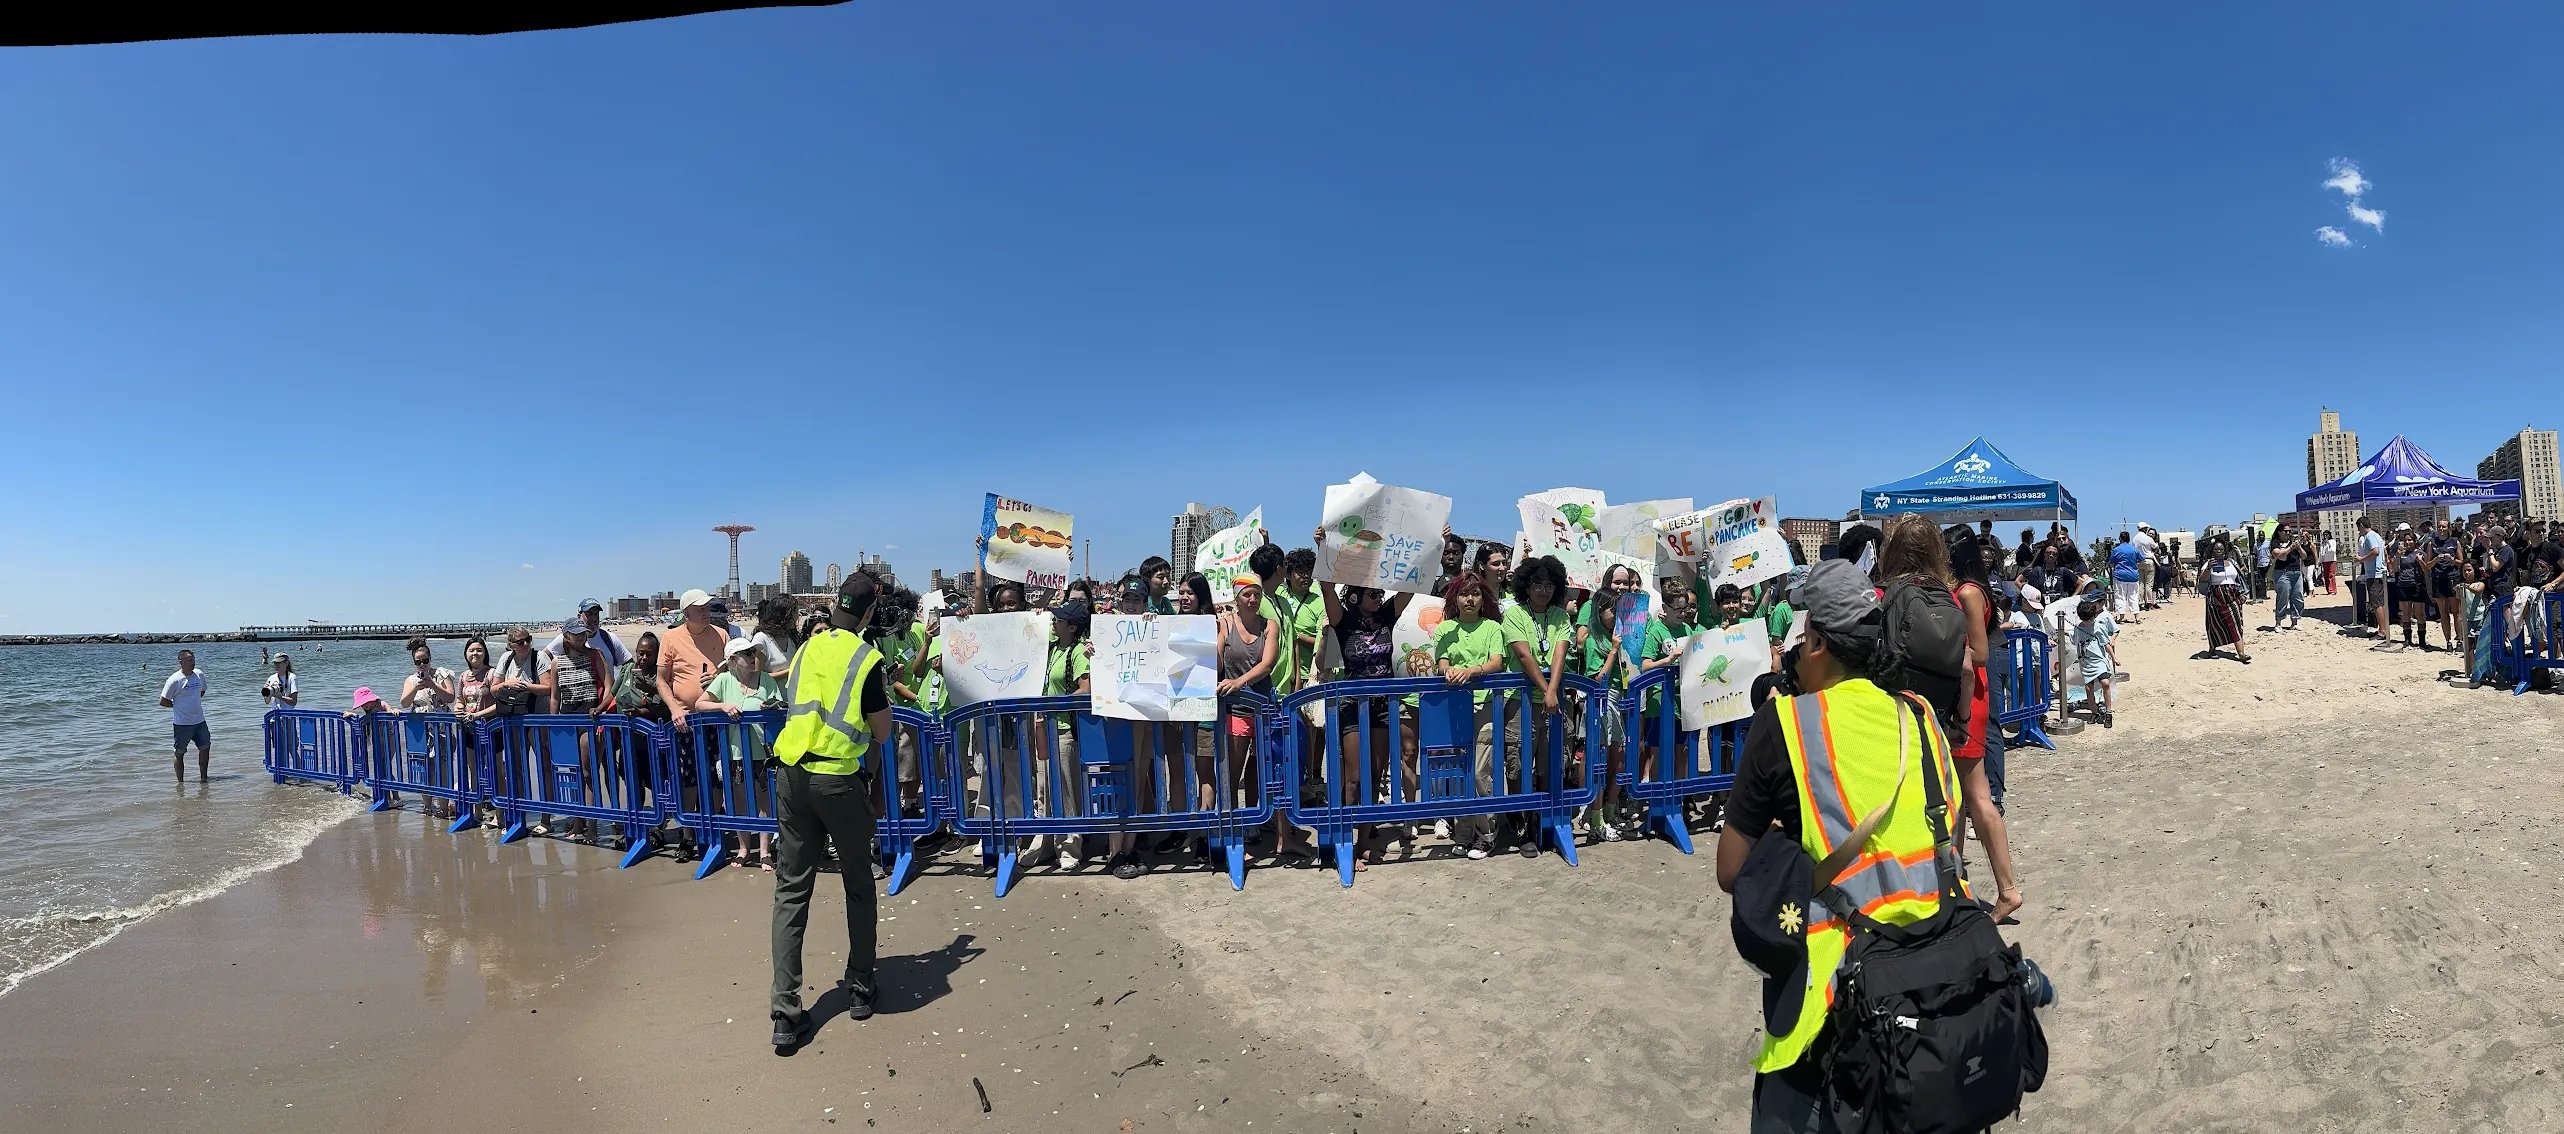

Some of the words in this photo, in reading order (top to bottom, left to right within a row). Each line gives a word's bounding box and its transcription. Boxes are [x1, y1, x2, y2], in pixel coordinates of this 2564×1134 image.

[1932, 495, 1969, 503] Stranding
[2405, 487, 2428, 497] New
[2428, 486, 2449, 496] York
[2451, 486, 2495, 498] Aquarium
[1715, 518, 1758, 546] PANCAKE
[1386, 533, 1425, 551] SAVE
[1384, 548, 1411, 560] THE
[1111, 619, 1161, 648] SAVE
[1115, 650, 1148, 671] THE
